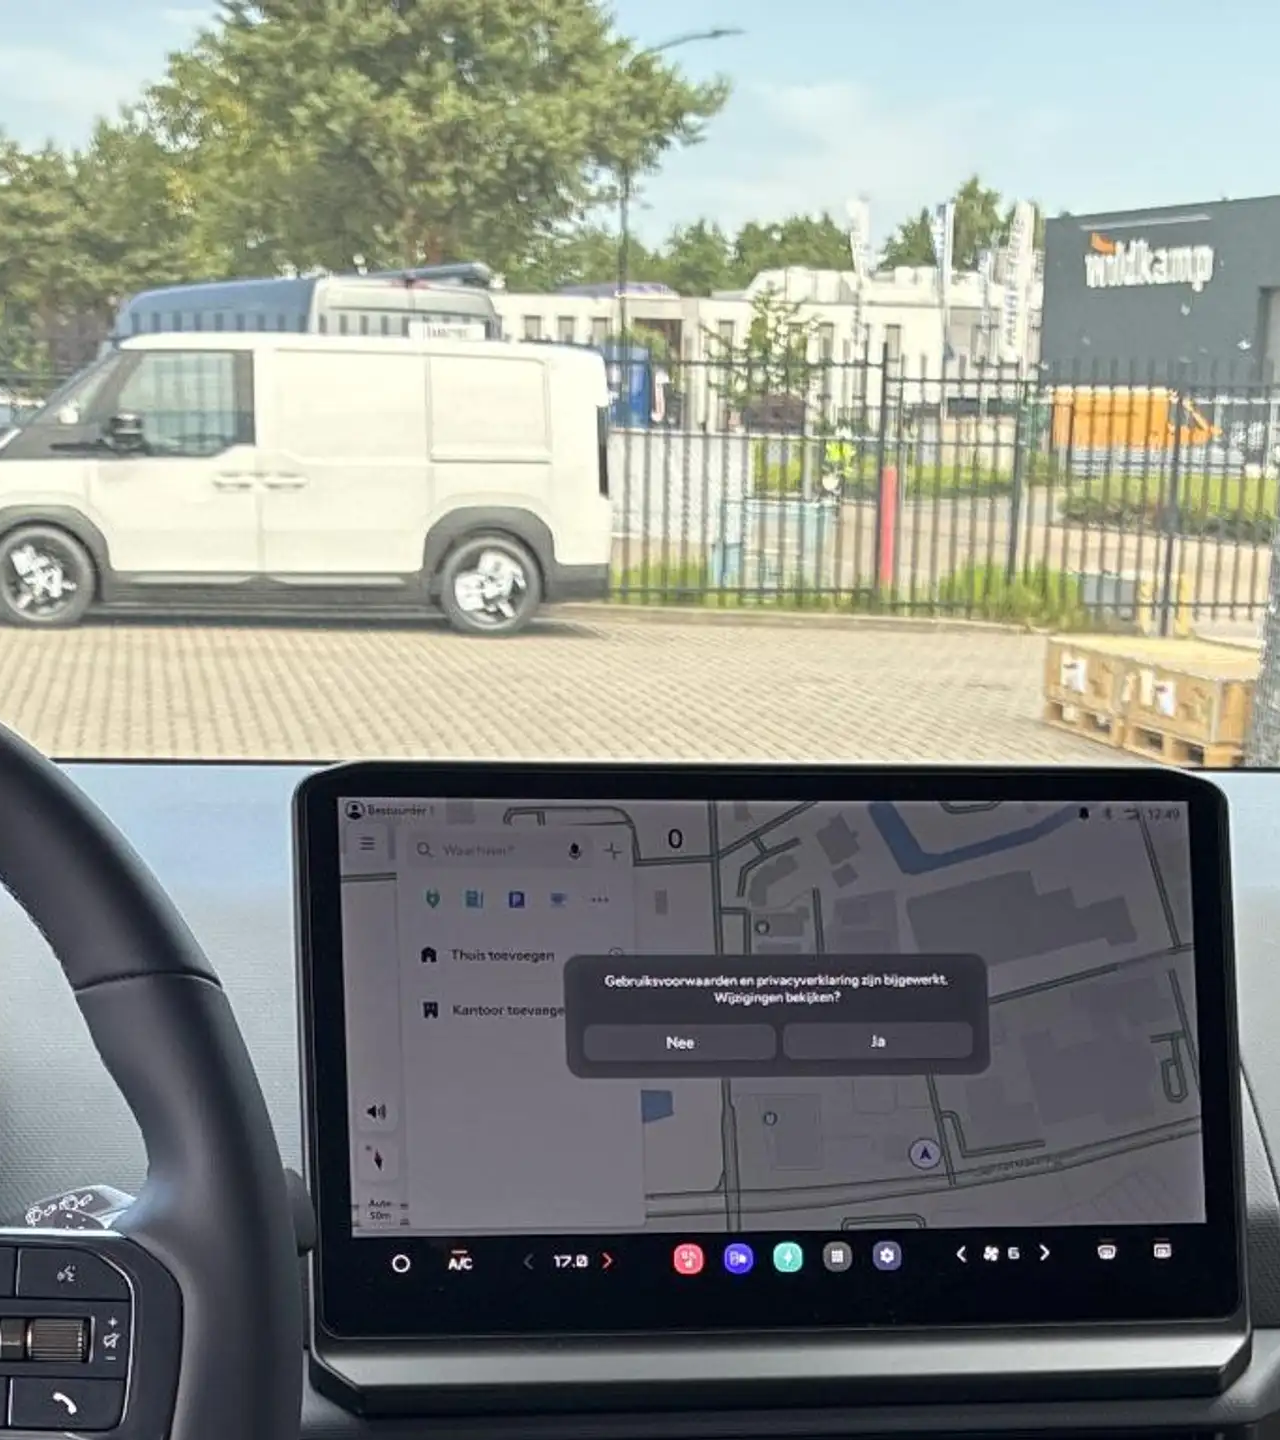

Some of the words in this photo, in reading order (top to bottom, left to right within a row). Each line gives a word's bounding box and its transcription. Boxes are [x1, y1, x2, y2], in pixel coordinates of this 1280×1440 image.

[451, 949, 486, 961] Thuis
[488, 951, 555, 963] toevoegen
[604, 974, 738, 988] Gebruiksvoorwaarden
[740, 976, 755, 987] en
[757, 974, 860, 988] privacyverklaring
[861, 974, 882, 987] zijn
[713, 991, 784, 1006] Wijzigingen
[785, 990, 842, 1004] bekijken?
[452, 1004, 505, 1016] Kantoor
[507, 1004, 566, 1018] toevoege
[666, 1036, 696, 1049] Nee
[870, 1035, 887, 1048] Ja
[448, 1257, 473, 1271] A/C
[553, 1254, 589, 1268] 17.0
